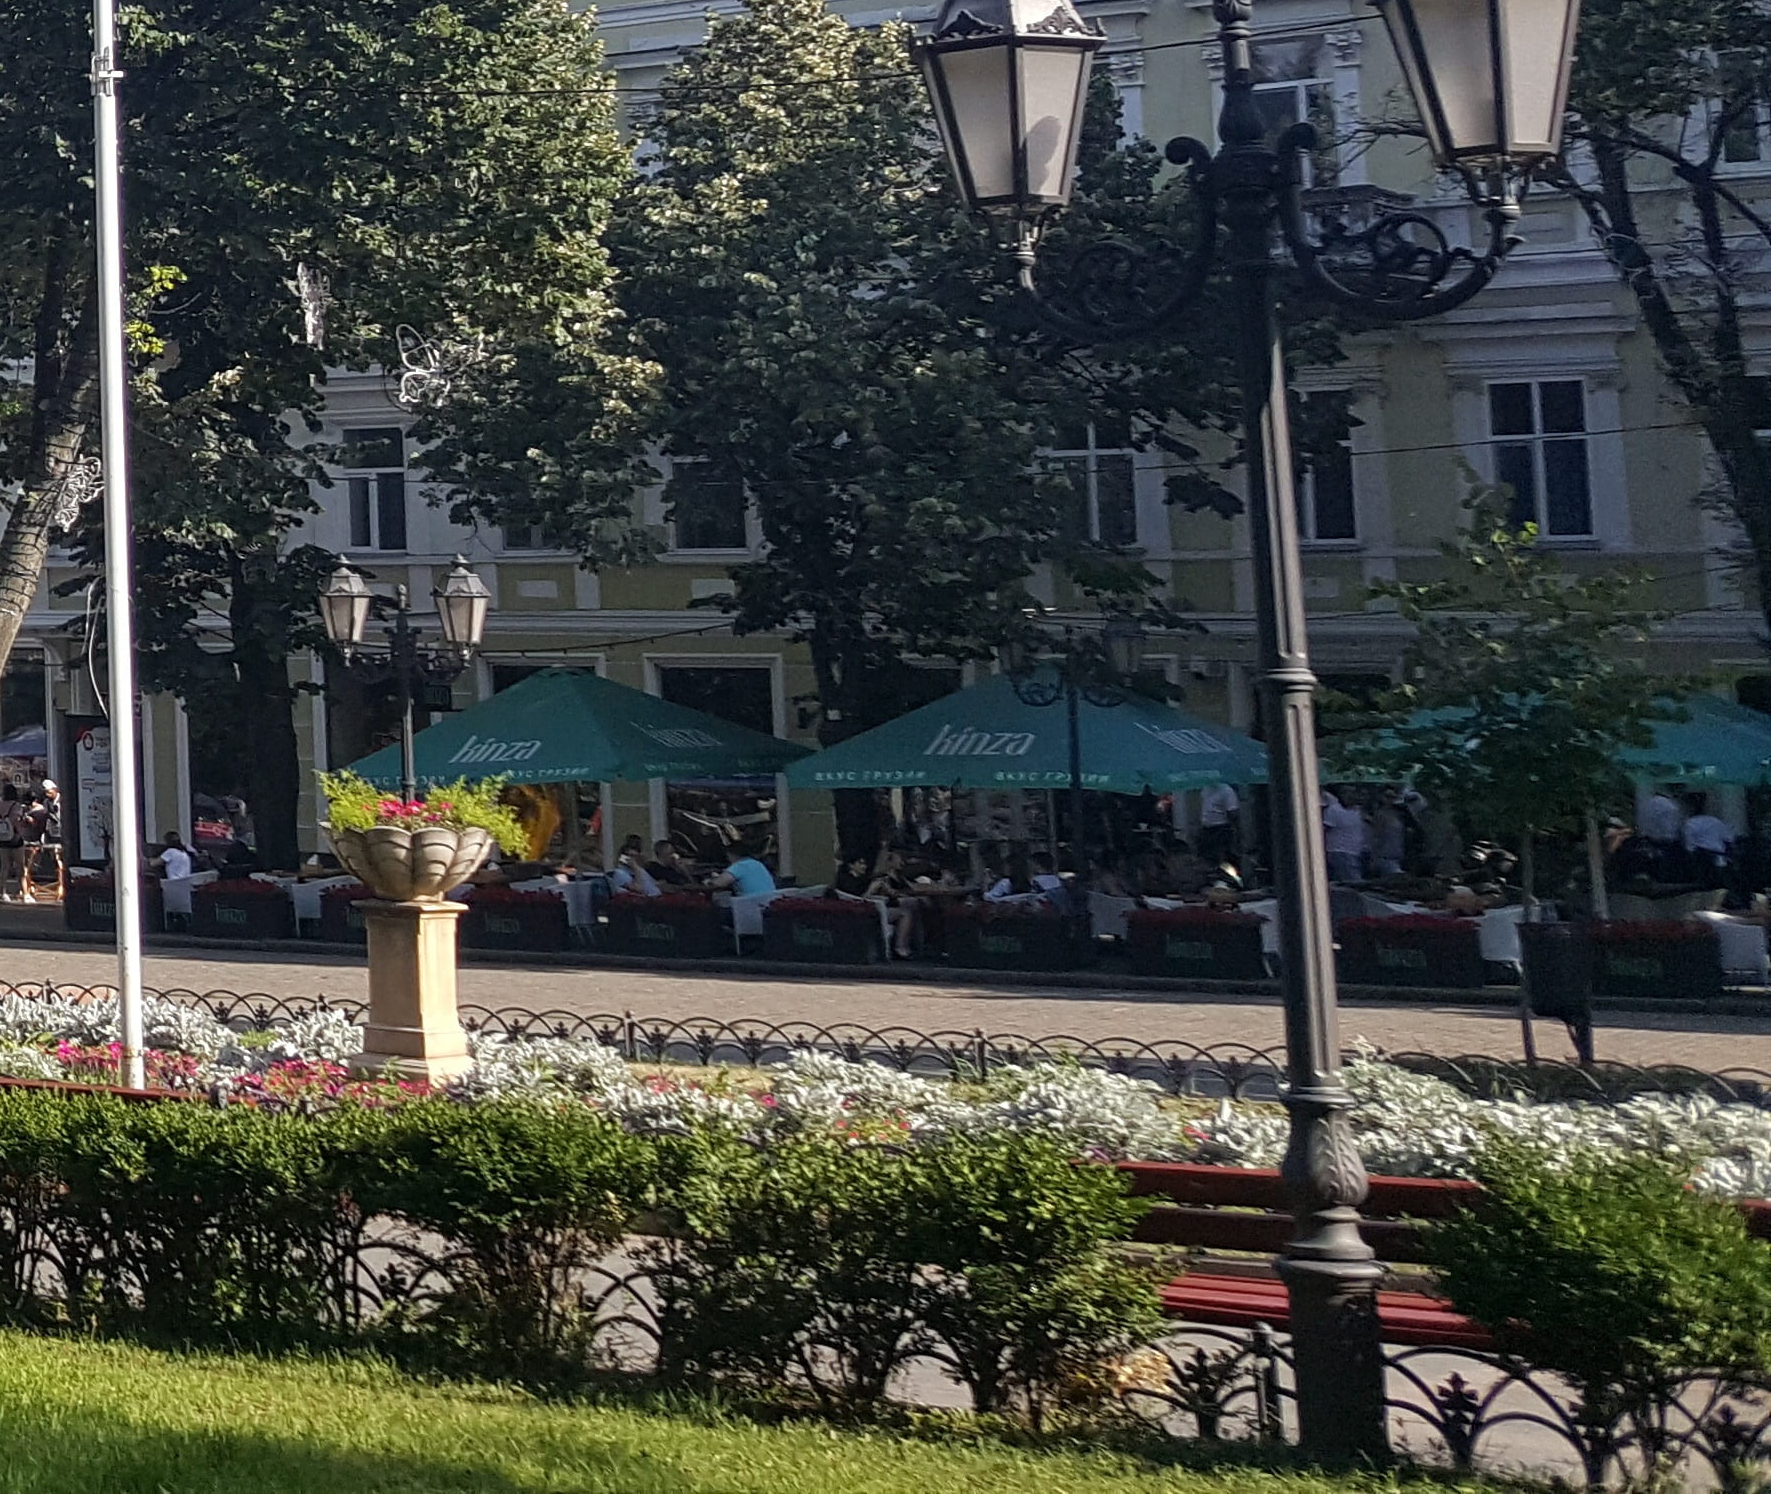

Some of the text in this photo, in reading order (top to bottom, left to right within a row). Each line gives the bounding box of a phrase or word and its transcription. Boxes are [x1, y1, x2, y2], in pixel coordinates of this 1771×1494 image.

[448, 735, 541, 764] kinza
[923, 723, 1036, 755] kinza
[814, 771, 857, 781] ВКУС
